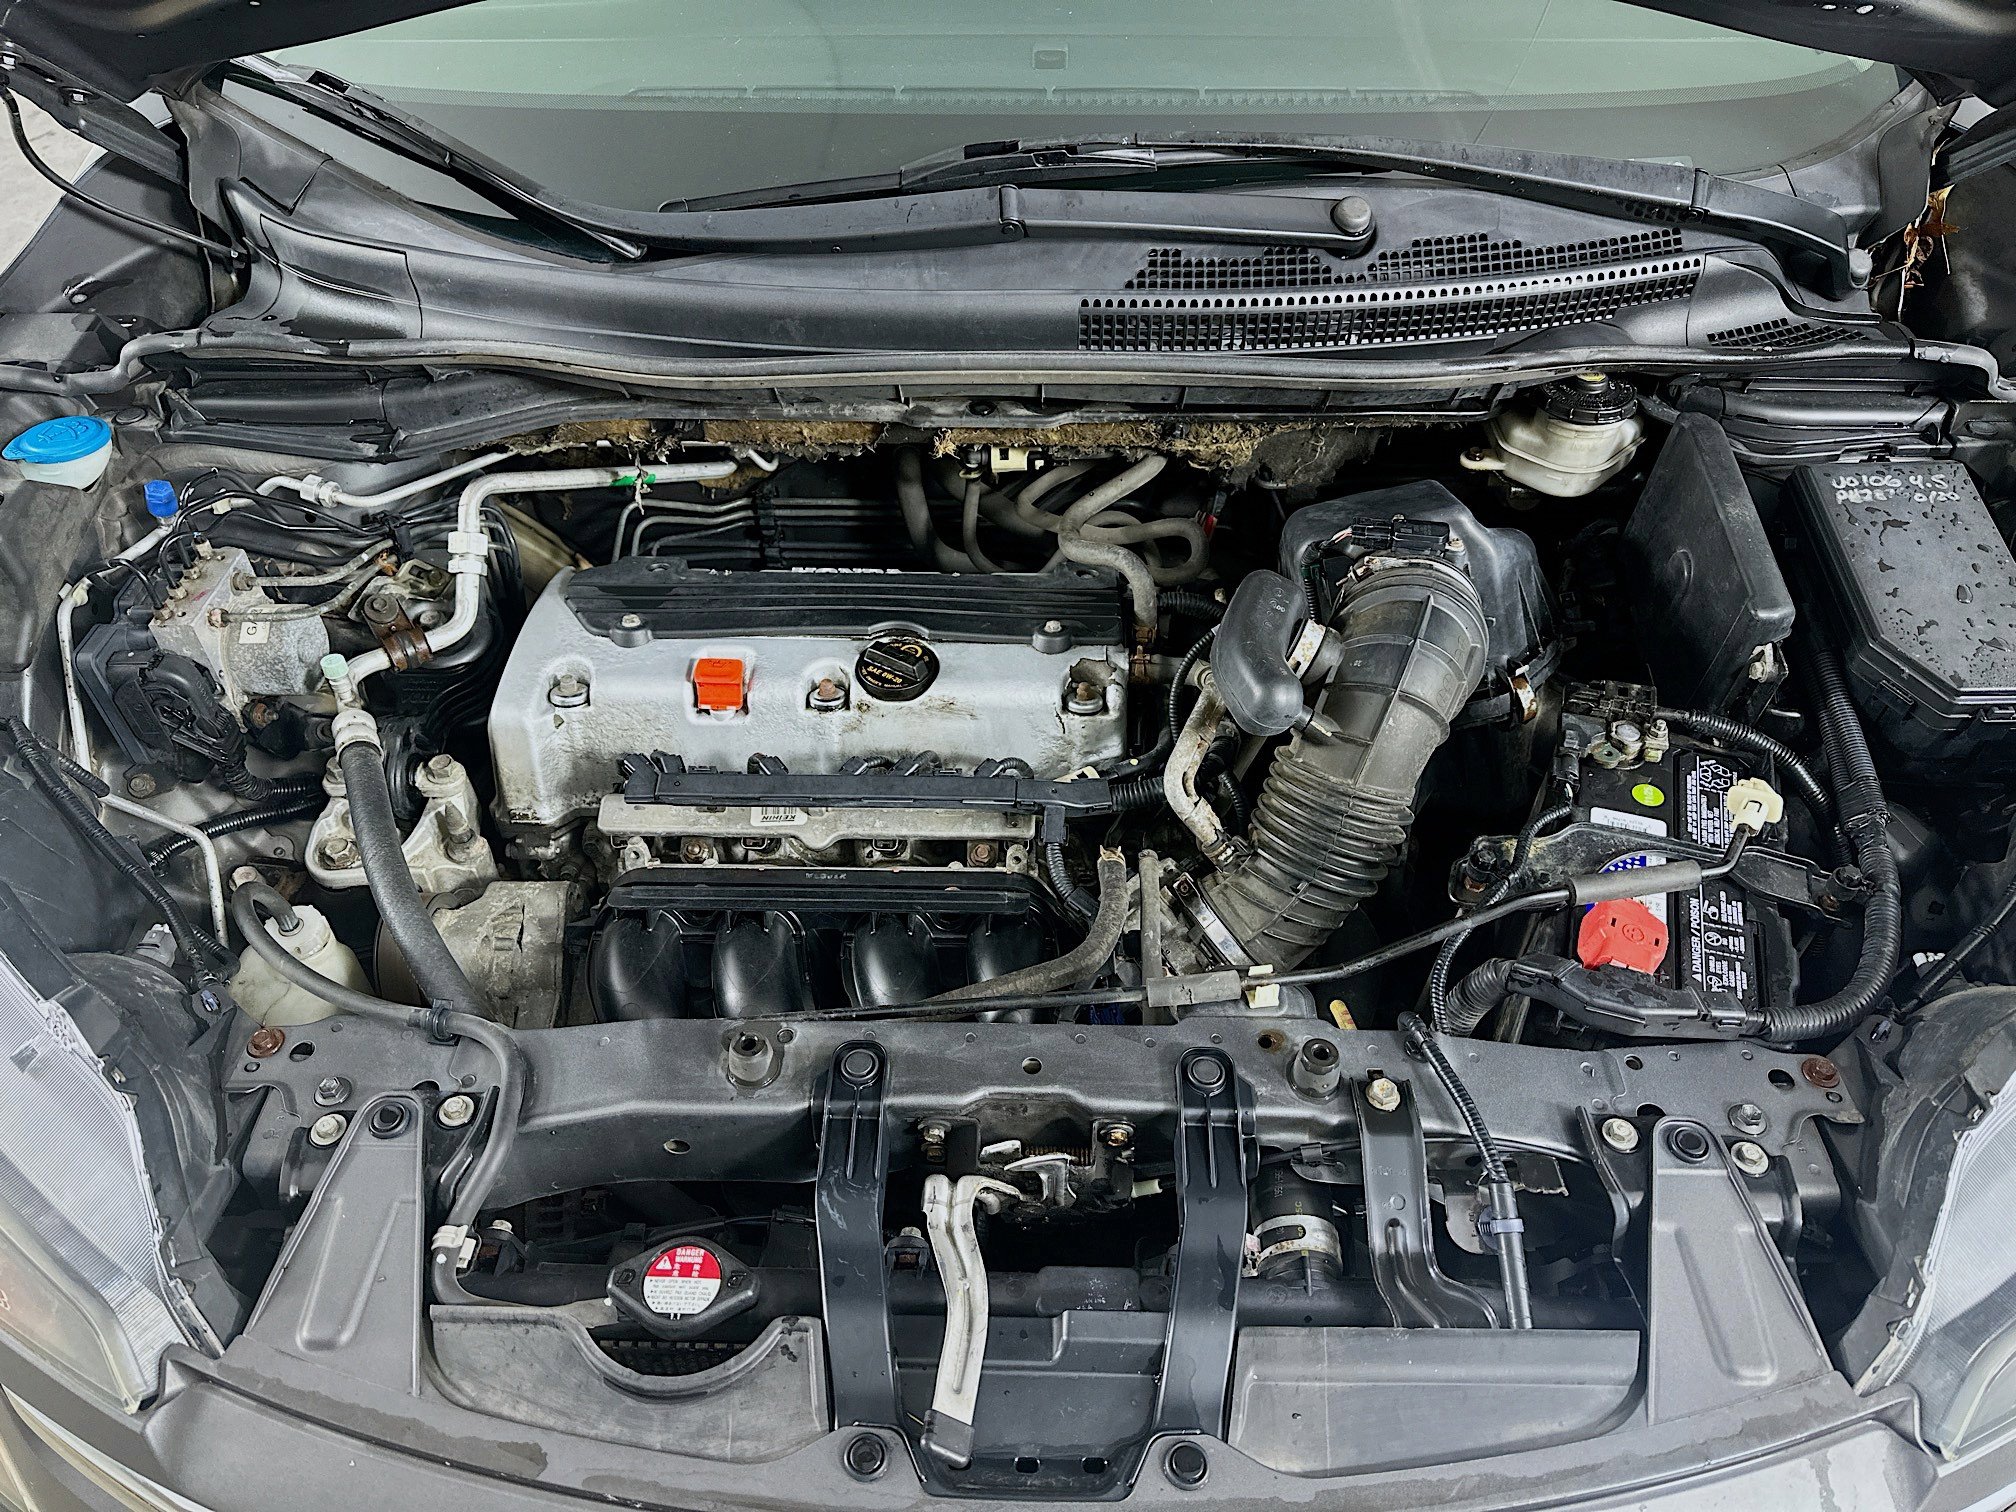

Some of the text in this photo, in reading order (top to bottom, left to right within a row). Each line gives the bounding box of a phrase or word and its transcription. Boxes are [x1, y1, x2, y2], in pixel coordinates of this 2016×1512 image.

[761, 814, 797, 822] KEIHIN
[1689, 897, 1701, 930] POISON
[1691, 936, 1702, 973] DANGER
[676, 1248, 705, 1256] DANGER
